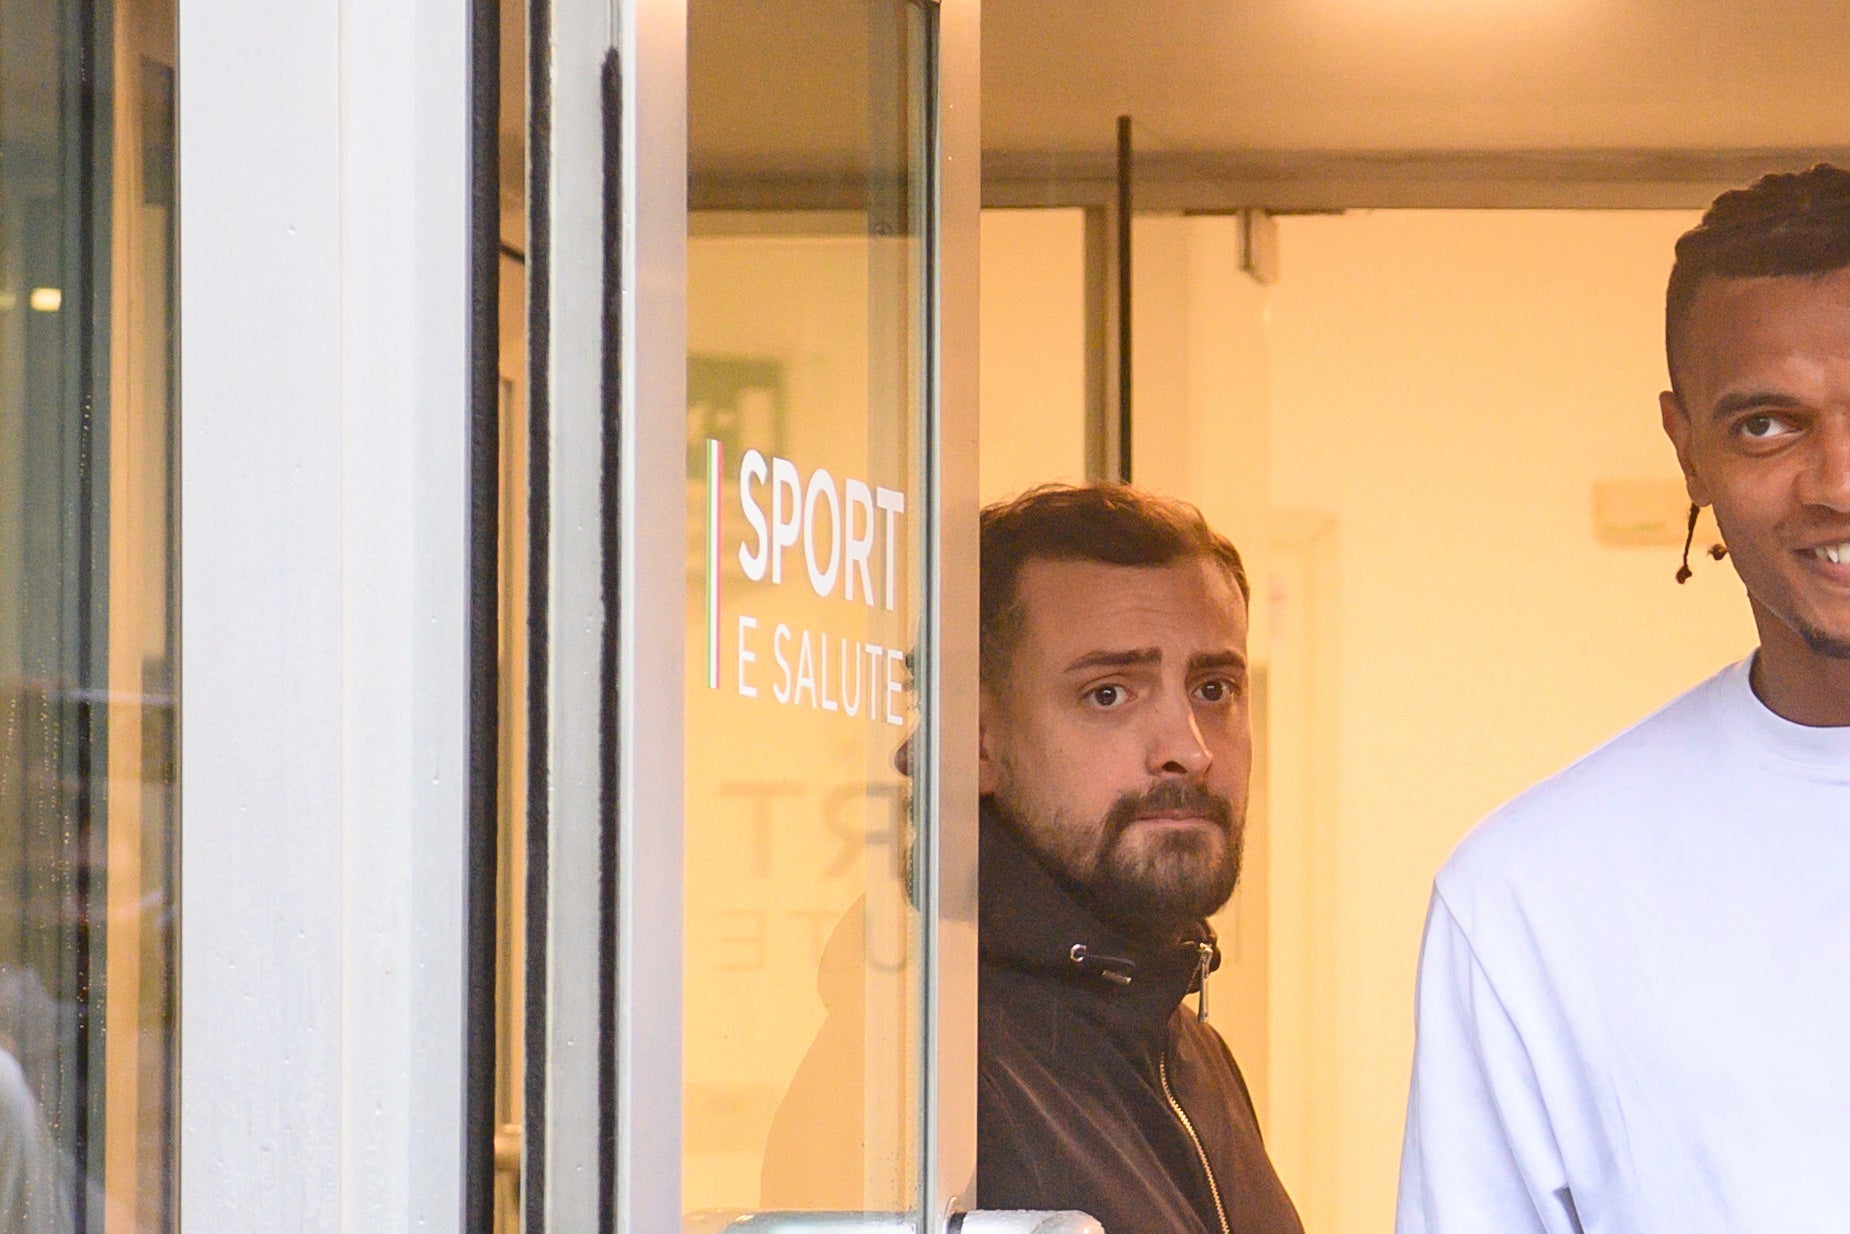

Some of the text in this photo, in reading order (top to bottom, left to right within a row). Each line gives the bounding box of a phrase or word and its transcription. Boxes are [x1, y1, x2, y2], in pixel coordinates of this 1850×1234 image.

[738, 449, 904, 610] SPORT
[737, 616, 904, 725] E SALUTE
